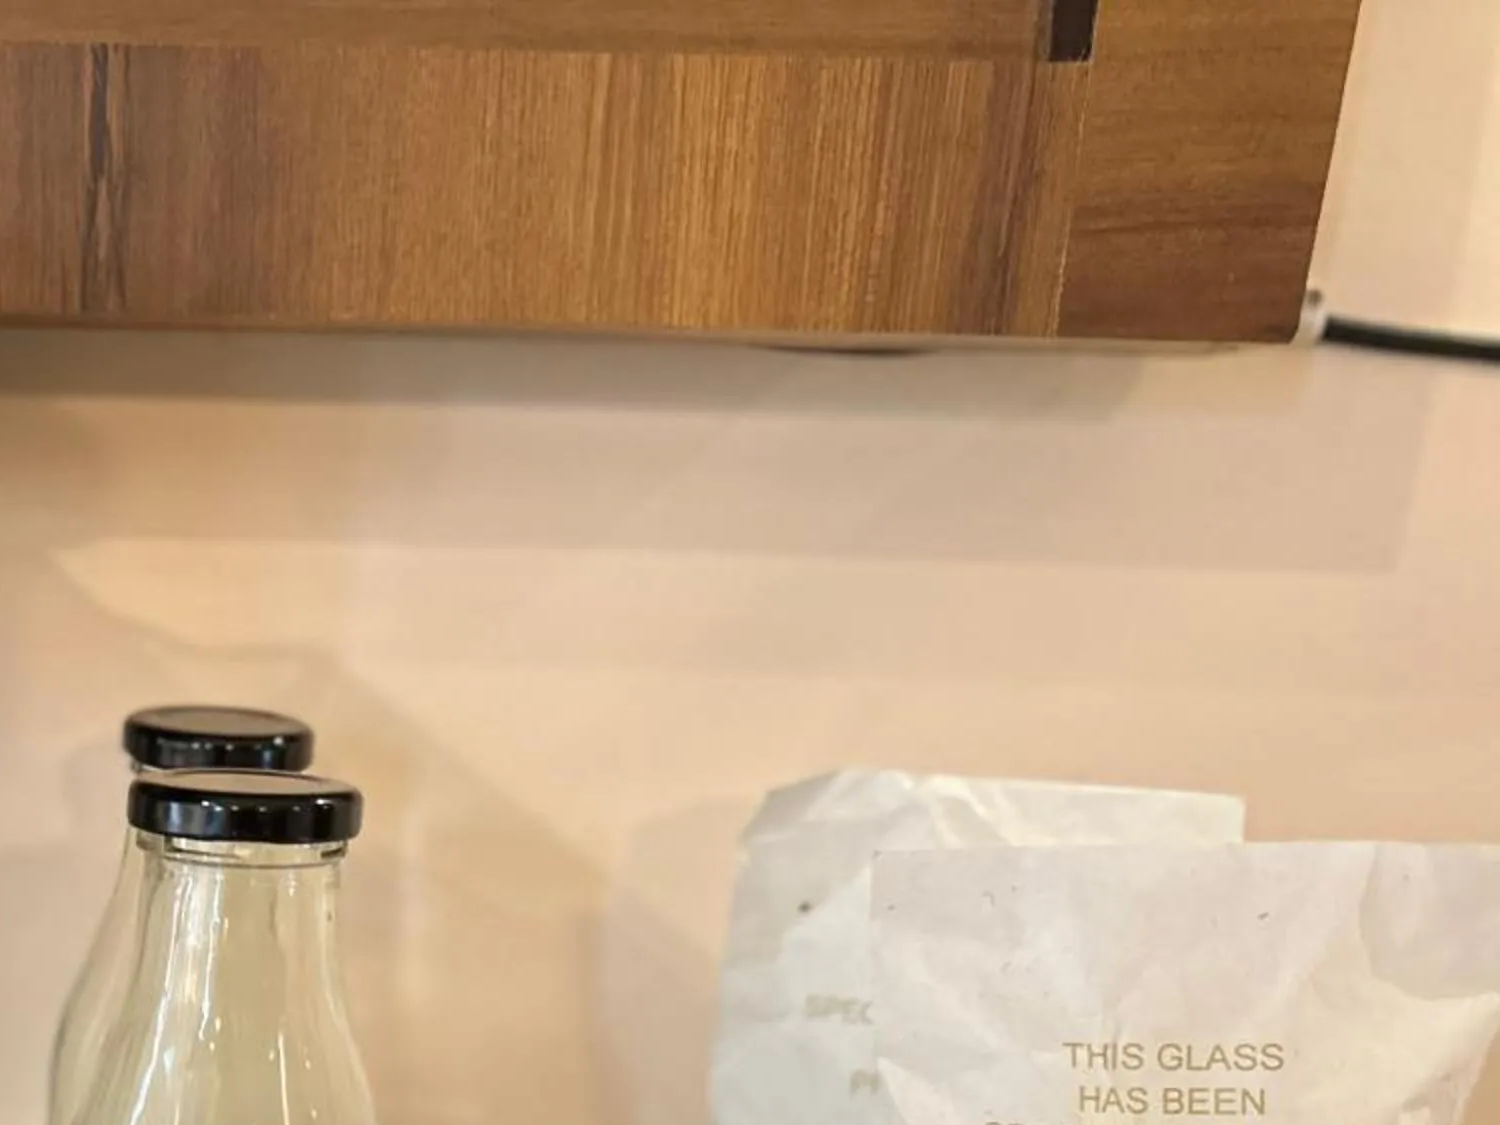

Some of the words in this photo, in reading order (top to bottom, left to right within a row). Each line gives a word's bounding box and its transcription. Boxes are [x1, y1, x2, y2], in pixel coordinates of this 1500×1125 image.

[1062, 1043, 1145, 1071] THIS
[1156, 1043, 1285, 1072] GLASS
[1078, 1086, 1148, 1115] HAS
[1161, 1087, 1266, 1116] BEEN
